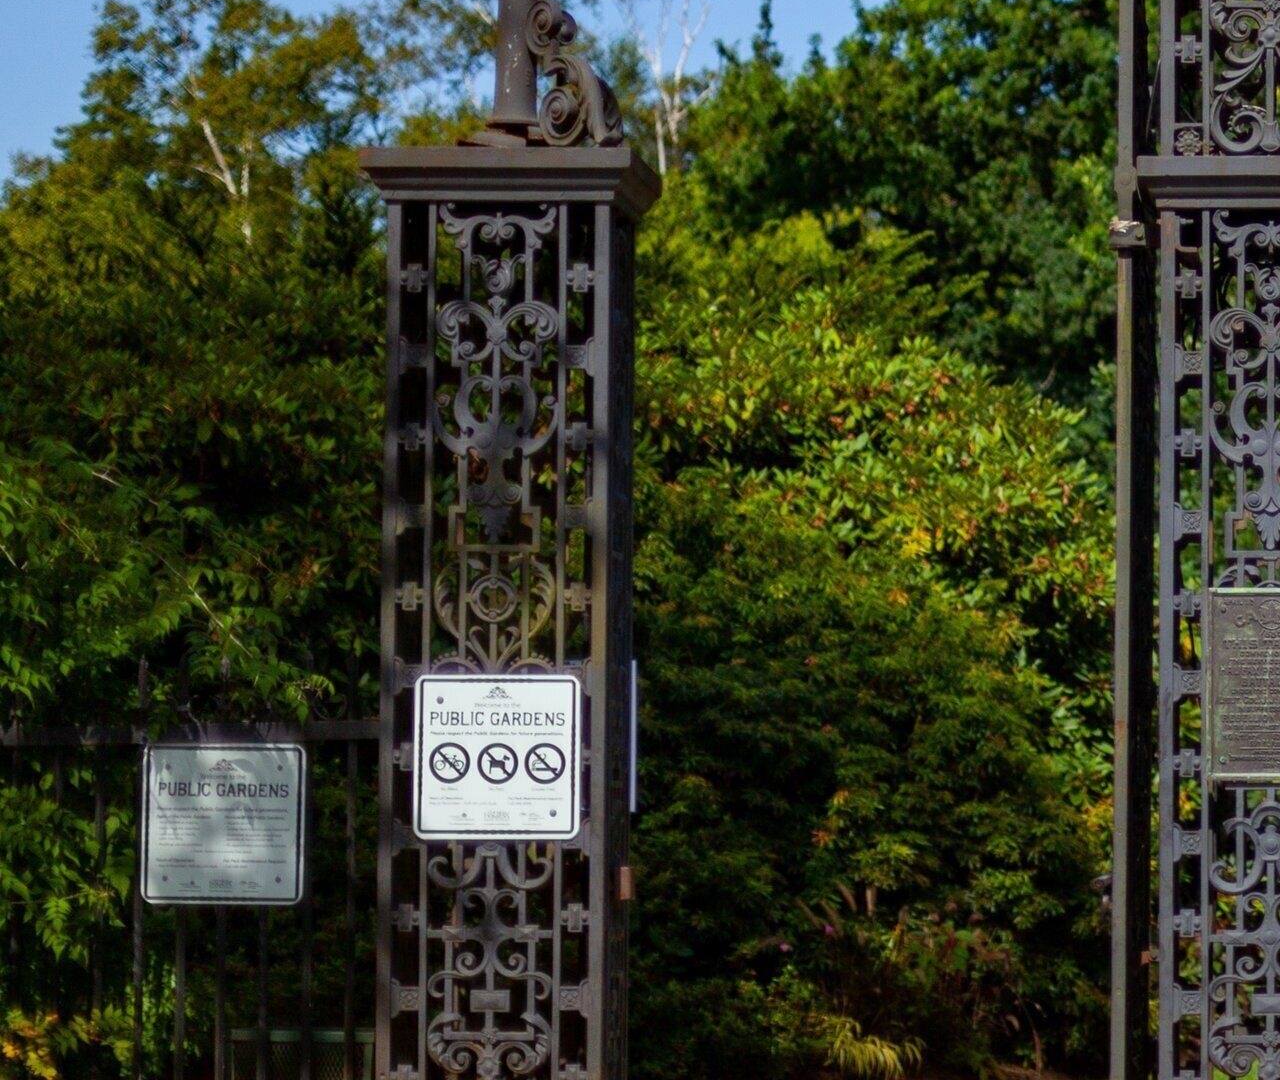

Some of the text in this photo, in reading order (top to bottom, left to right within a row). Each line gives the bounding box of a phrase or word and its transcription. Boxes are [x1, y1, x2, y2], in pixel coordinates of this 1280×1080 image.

[430, 711, 565, 727] PUBLIC GARDENS
[158, 781, 289, 798] PUBLIC GARDENS
